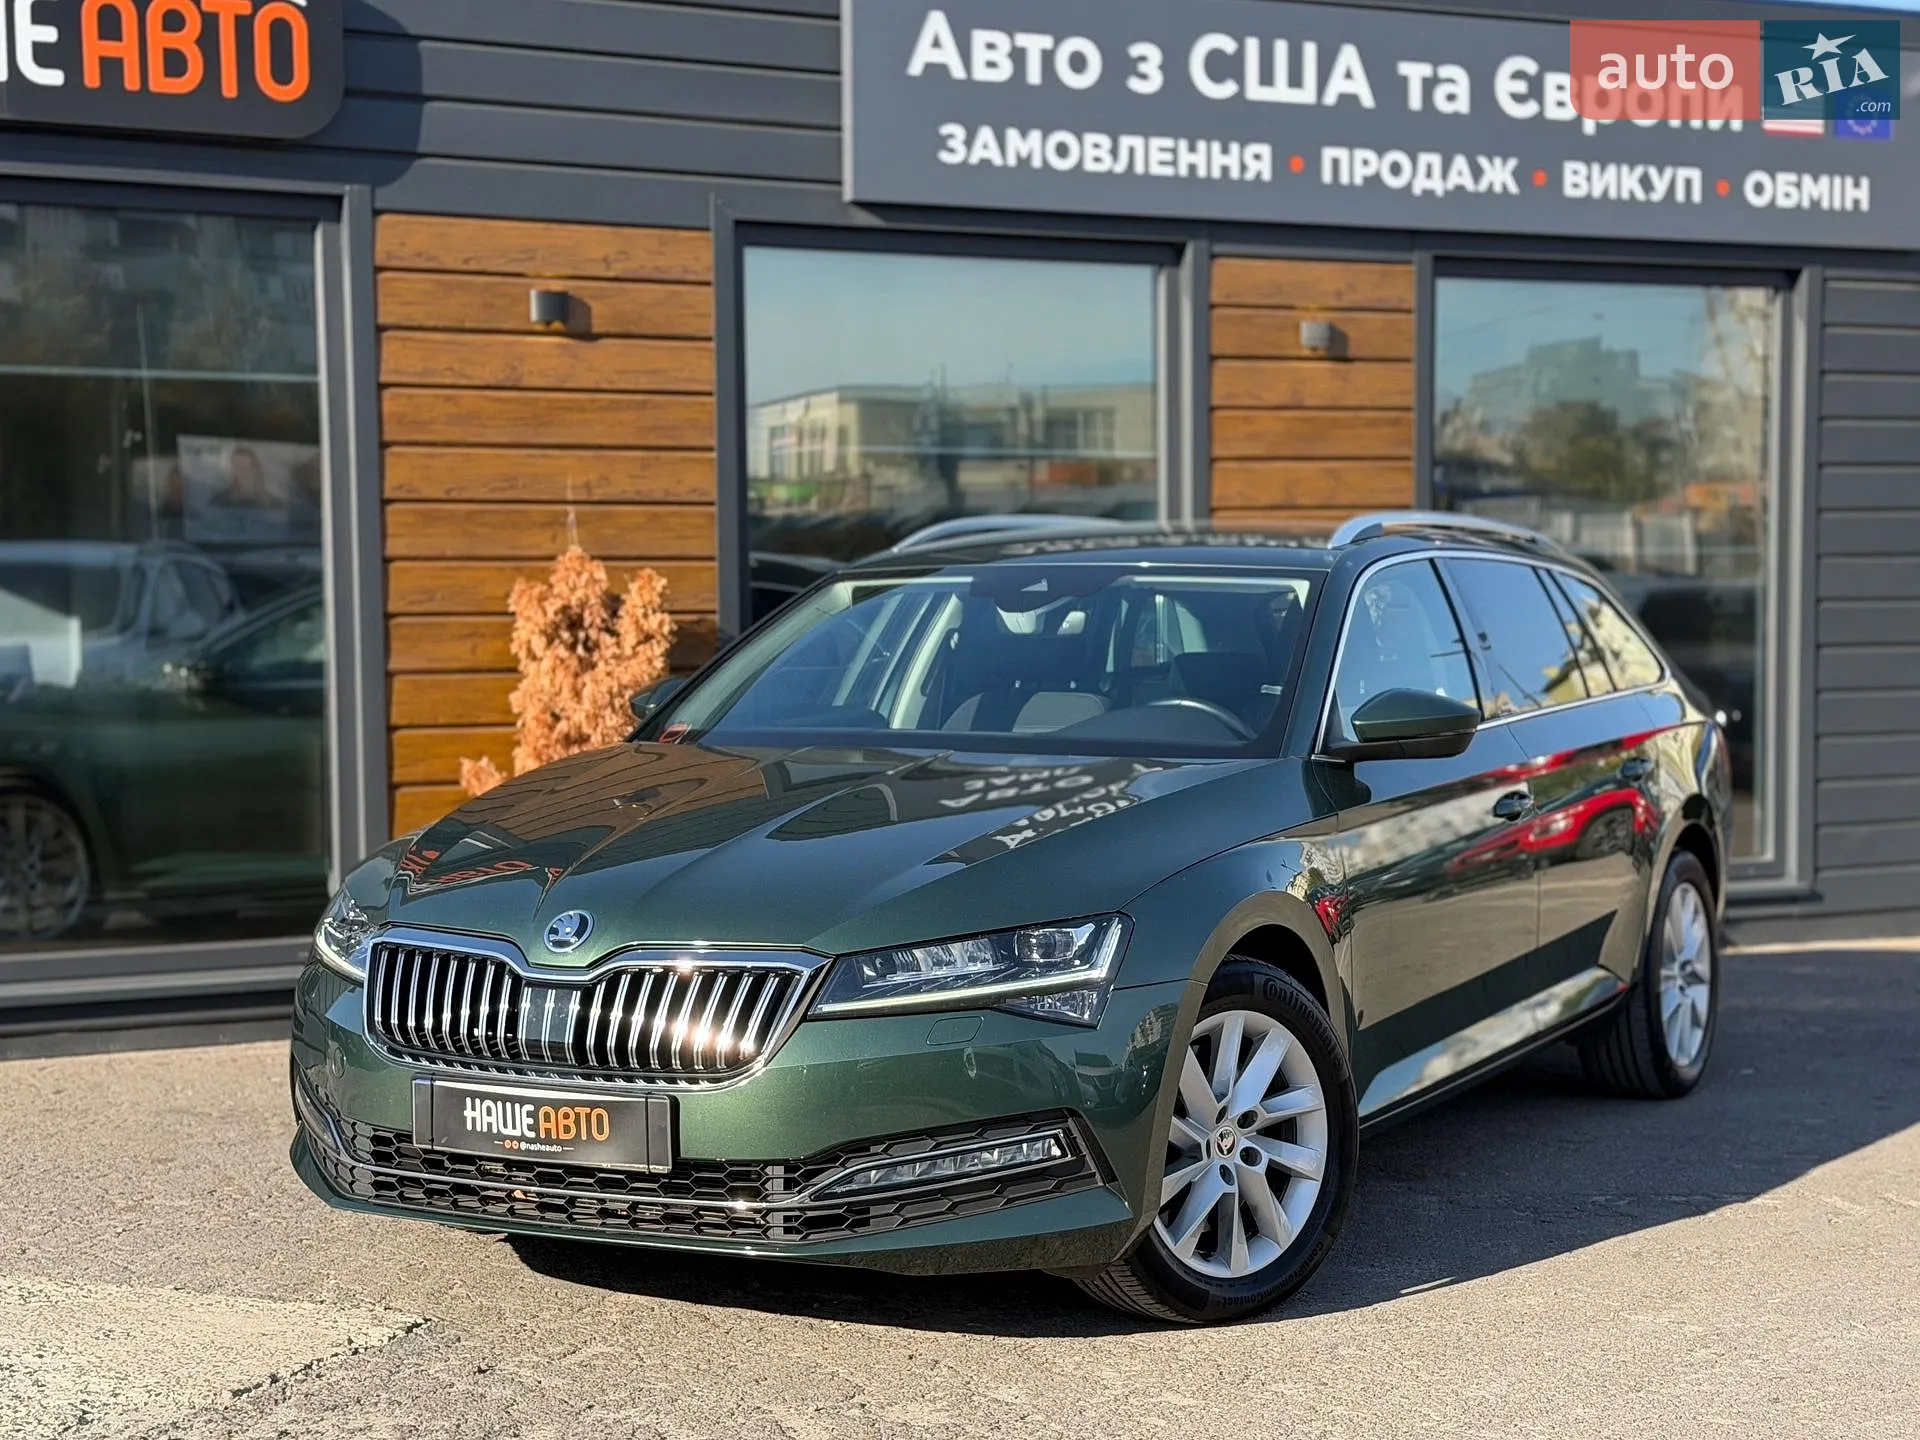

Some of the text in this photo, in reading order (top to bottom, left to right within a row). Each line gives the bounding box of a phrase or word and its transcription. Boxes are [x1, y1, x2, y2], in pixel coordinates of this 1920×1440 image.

[907, 10, 1743, 136] Авто з США та Європи
[937, 123, 1871, 212] ЗАМОВЛЕННЯ ПРОДАЖ ВИКУП ОБМІН
